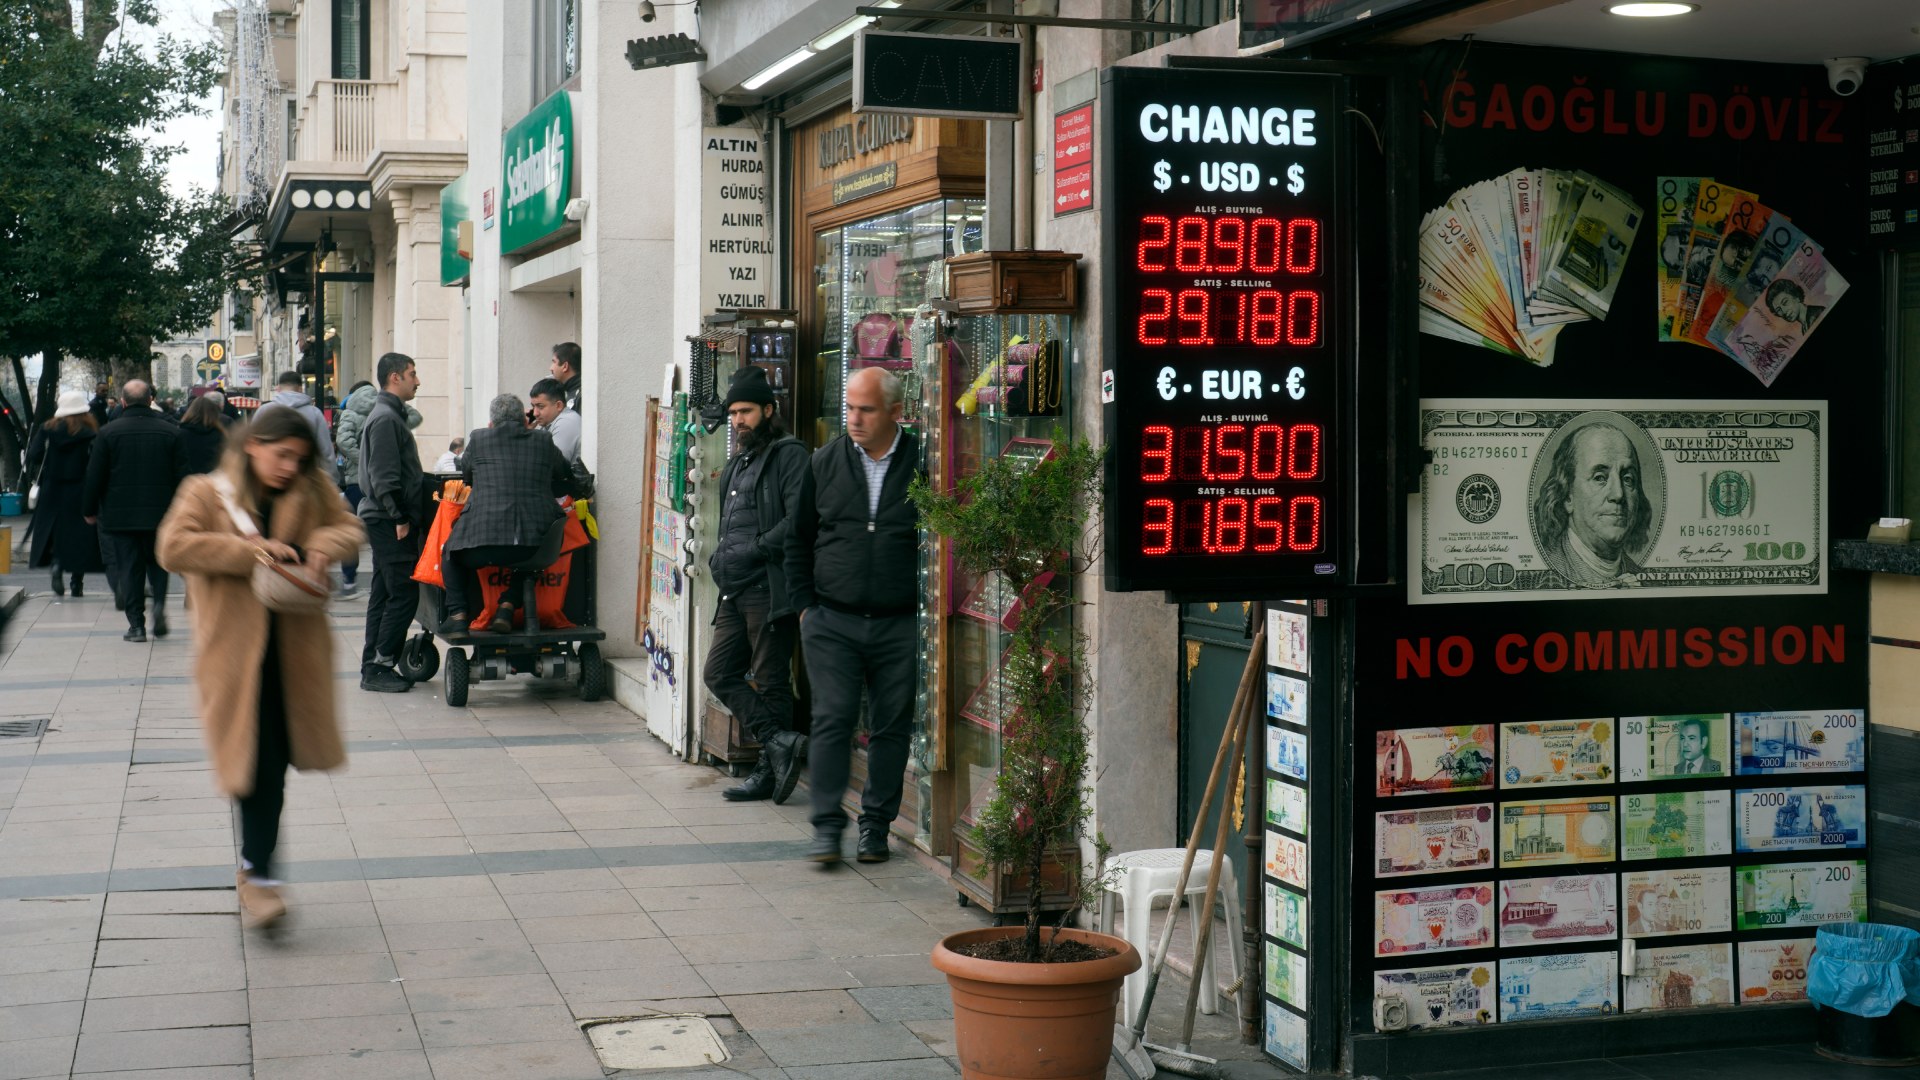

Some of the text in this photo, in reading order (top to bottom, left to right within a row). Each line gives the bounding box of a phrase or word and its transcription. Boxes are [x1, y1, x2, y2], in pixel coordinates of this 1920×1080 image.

[1421, 68, 1848, 144] ĞAOĞLU DÖVİZ
[1139, 103, 1317, 146] CHANGE
[707, 139, 757, 153] ALTIN
[819, 123, 855, 170] KUPA
[722, 159, 765, 174] HURDA
[507, 125, 551, 227] Şekerbank
[1153, 159, 1305, 196] $ USD $
[720, 183, 764, 204] GÜMÜŞ
[1660, 179, 1678, 219] 100
[1699, 184, 1720, 215] 50
[1195, 206, 1263, 215] ALIŞ BUYING
[1732, 200, 1754, 231] 20
[721, 213, 763, 227] ALINIR
[1444, 217, 1462, 236] 50
[709, 237, 774, 254] HERTÜRLÜ
[1138, 216, 1318, 274] 28.900
[1459, 233, 1477, 254] EURO
[1765, 226, 1792, 257] 10
[1801, 242, 1814, 257] 5
[729, 267, 756, 281] YAZI
[1194, 279, 1272, 289] SATIŞ SELLING
[718, 294, 766, 308] YAZILIR
[1138, 289, 1319, 345] 29.180
[1157, 366, 1306, 400] € EUR €
[1200, 414, 1269, 424] ALIŞ BUYING
[1439, 411, 1538, 428] 100
[1718, 412, 1810, 428] 100
[1708, 430, 1748, 438] THE
[1659, 437, 1794, 450] UNITED STATES
[1141, 424, 1320, 482] 31.500
[1675, 449, 1781, 463] OF AMERICA
[1433, 463, 1449, 475] B2
[1197, 487, 1275, 497] SATIŞ SELLING
[1142, 496, 1320, 555] 31.850
[1743, 541, 1807, 561] 100
[1438, 562, 1517, 588] 100
[1636, 569, 1811, 581] ONE HUNDRED DOLLARS
[1395, 624, 1846, 681] NO COMMISSION
[1626, 722, 1643, 735] 50
[1823, 714, 1857, 728] 2000
[1759, 757, 1780, 767] 2000
[1785, 759, 1850, 769] ДВЕ ТЫСЯЧИ РУБЛЕЙ
[1628, 797, 1641, 808] 50
[1752, 792, 1785, 807] 2000
[1761, 837, 1820, 847] ДВЕ ТЫСЯЧИ РУБЛЕЙ
[1823, 834, 1844, 844] 2000
[1825, 866, 1851, 881] 200
[1765, 913, 1782, 924] 200
[1799, 911, 1852, 922] ДВЕСТИ РУБЛЕЙ
[1684, 919, 1702, 931] 100
[1772, 968, 1807, 981] ๑๐๐
